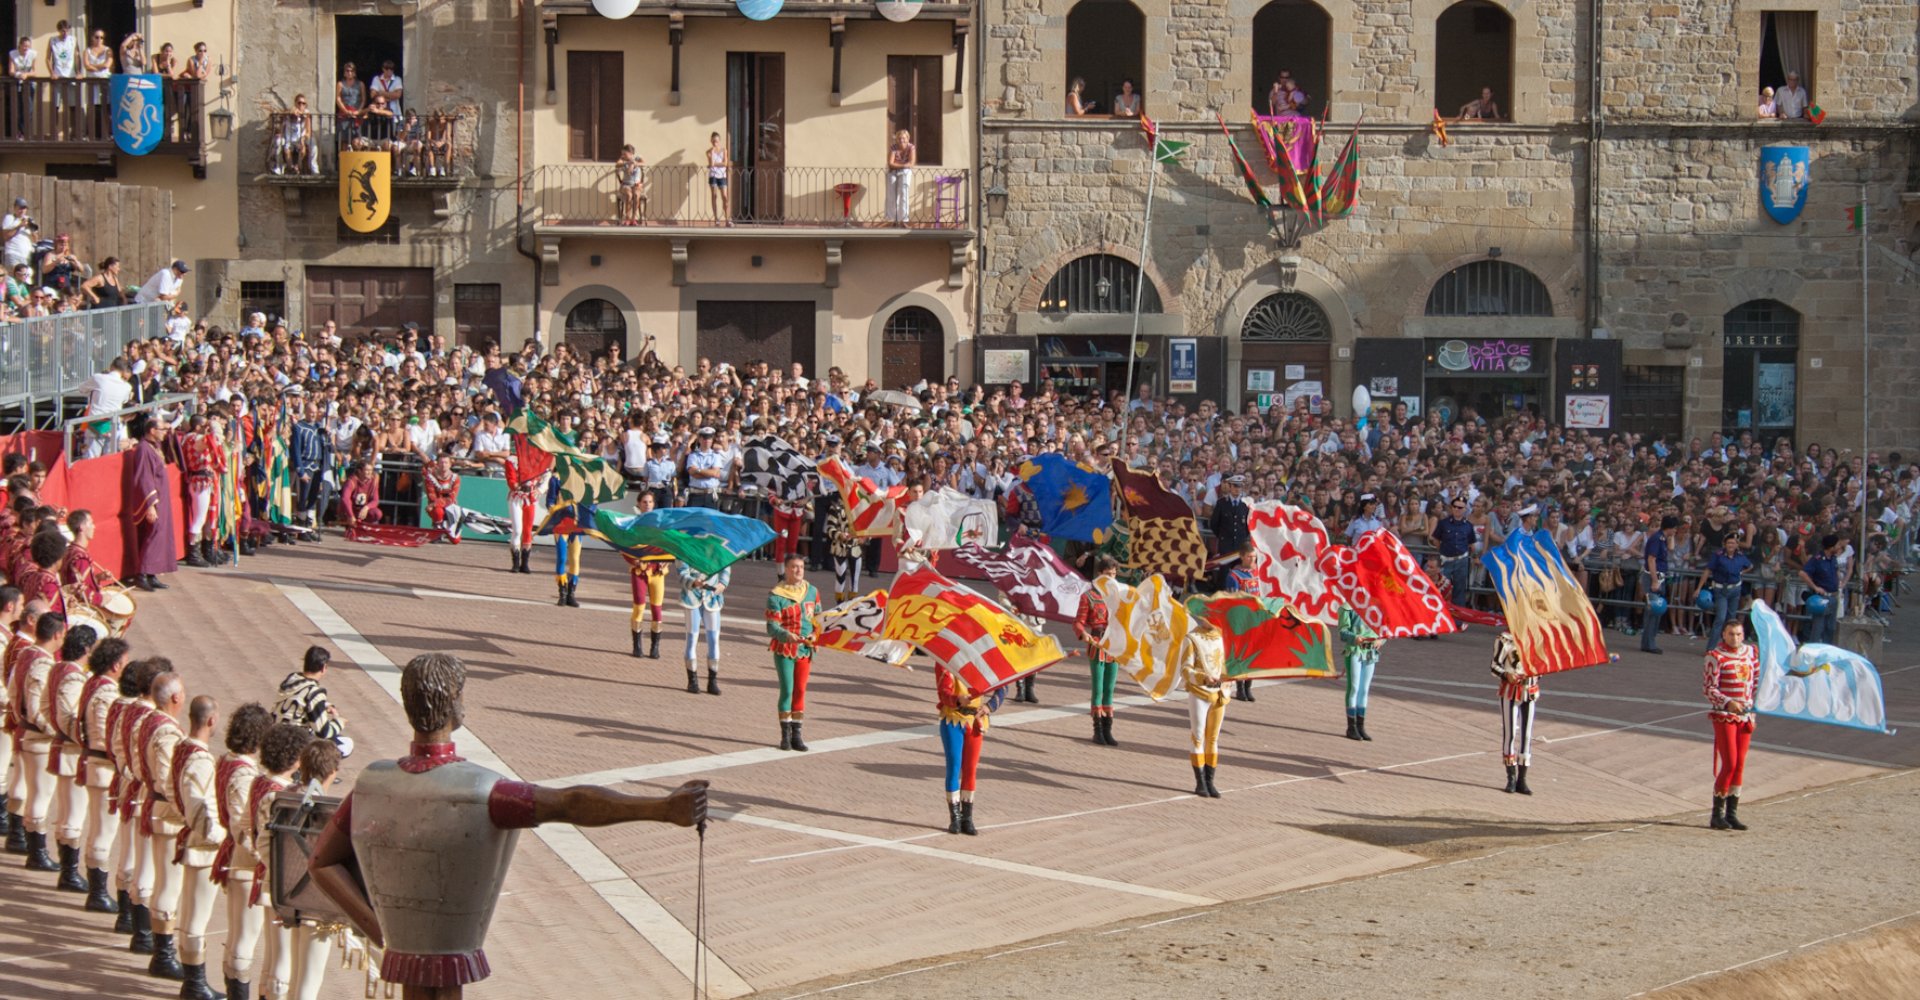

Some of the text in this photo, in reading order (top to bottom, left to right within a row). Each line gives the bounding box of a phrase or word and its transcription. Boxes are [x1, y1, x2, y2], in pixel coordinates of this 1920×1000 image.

[1483, 339, 1506, 349] LA
[1725, 336, 1782, 345] ARETE
[1469, 344, 1531, 357] DOLCE
